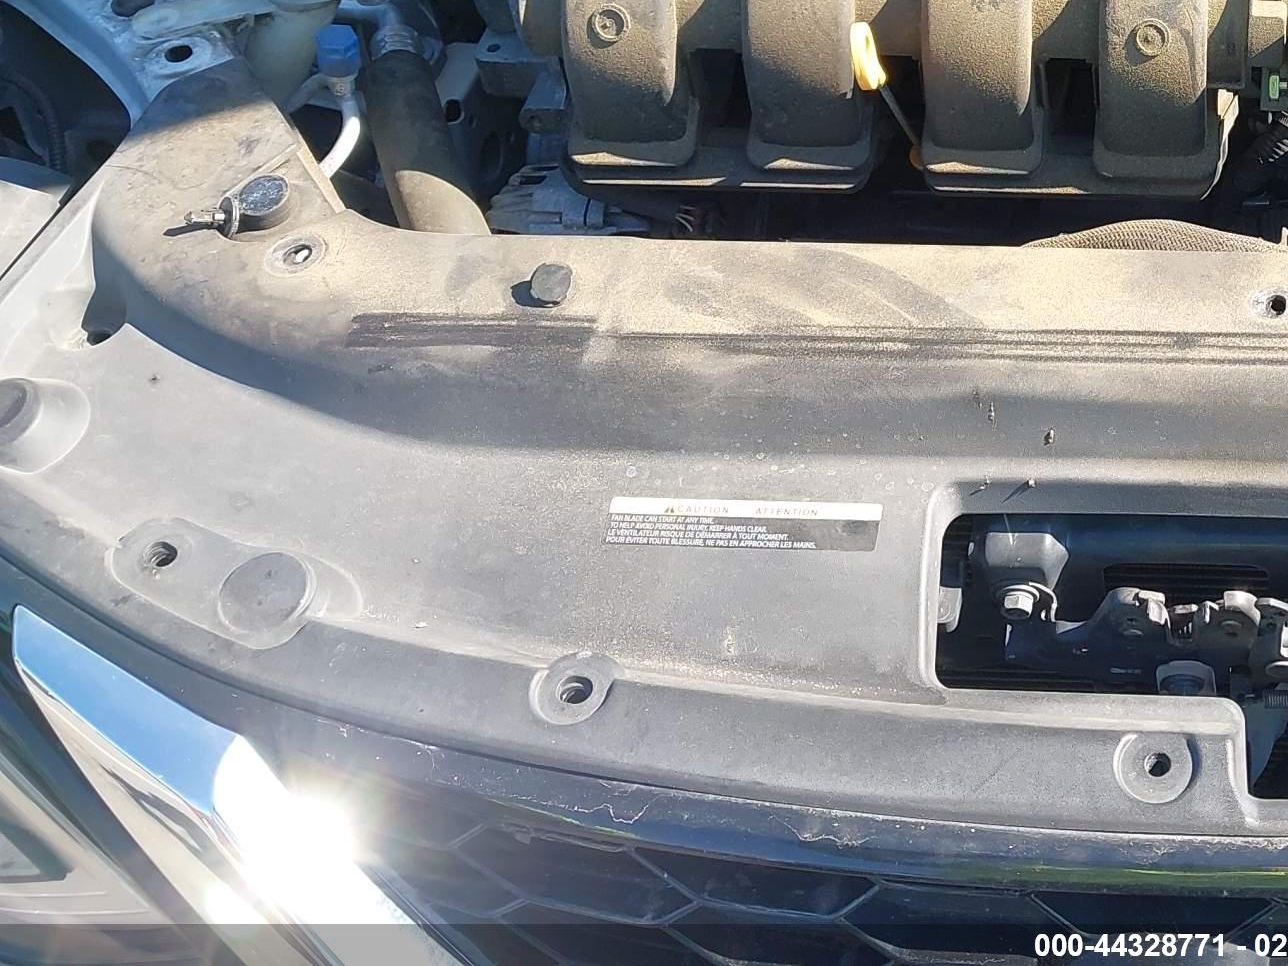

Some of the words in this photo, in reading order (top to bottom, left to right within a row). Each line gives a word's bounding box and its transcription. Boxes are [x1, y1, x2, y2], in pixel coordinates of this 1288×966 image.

[677, 505, 729, 514] CAUTION
[755, 507, 818, 517] ATTENTION
[658, 516, 676, 524] START
[635, 522, 655, 530] AVOID
[655, 523, 686, 531] PERSONAL
[616, 529, 660, 537] VENTILATEUR
[660, 530, 685, 538] RISQUE
[606, 535, 625, 543] POUR
[740, 540, 780, 548] APPROCHER
